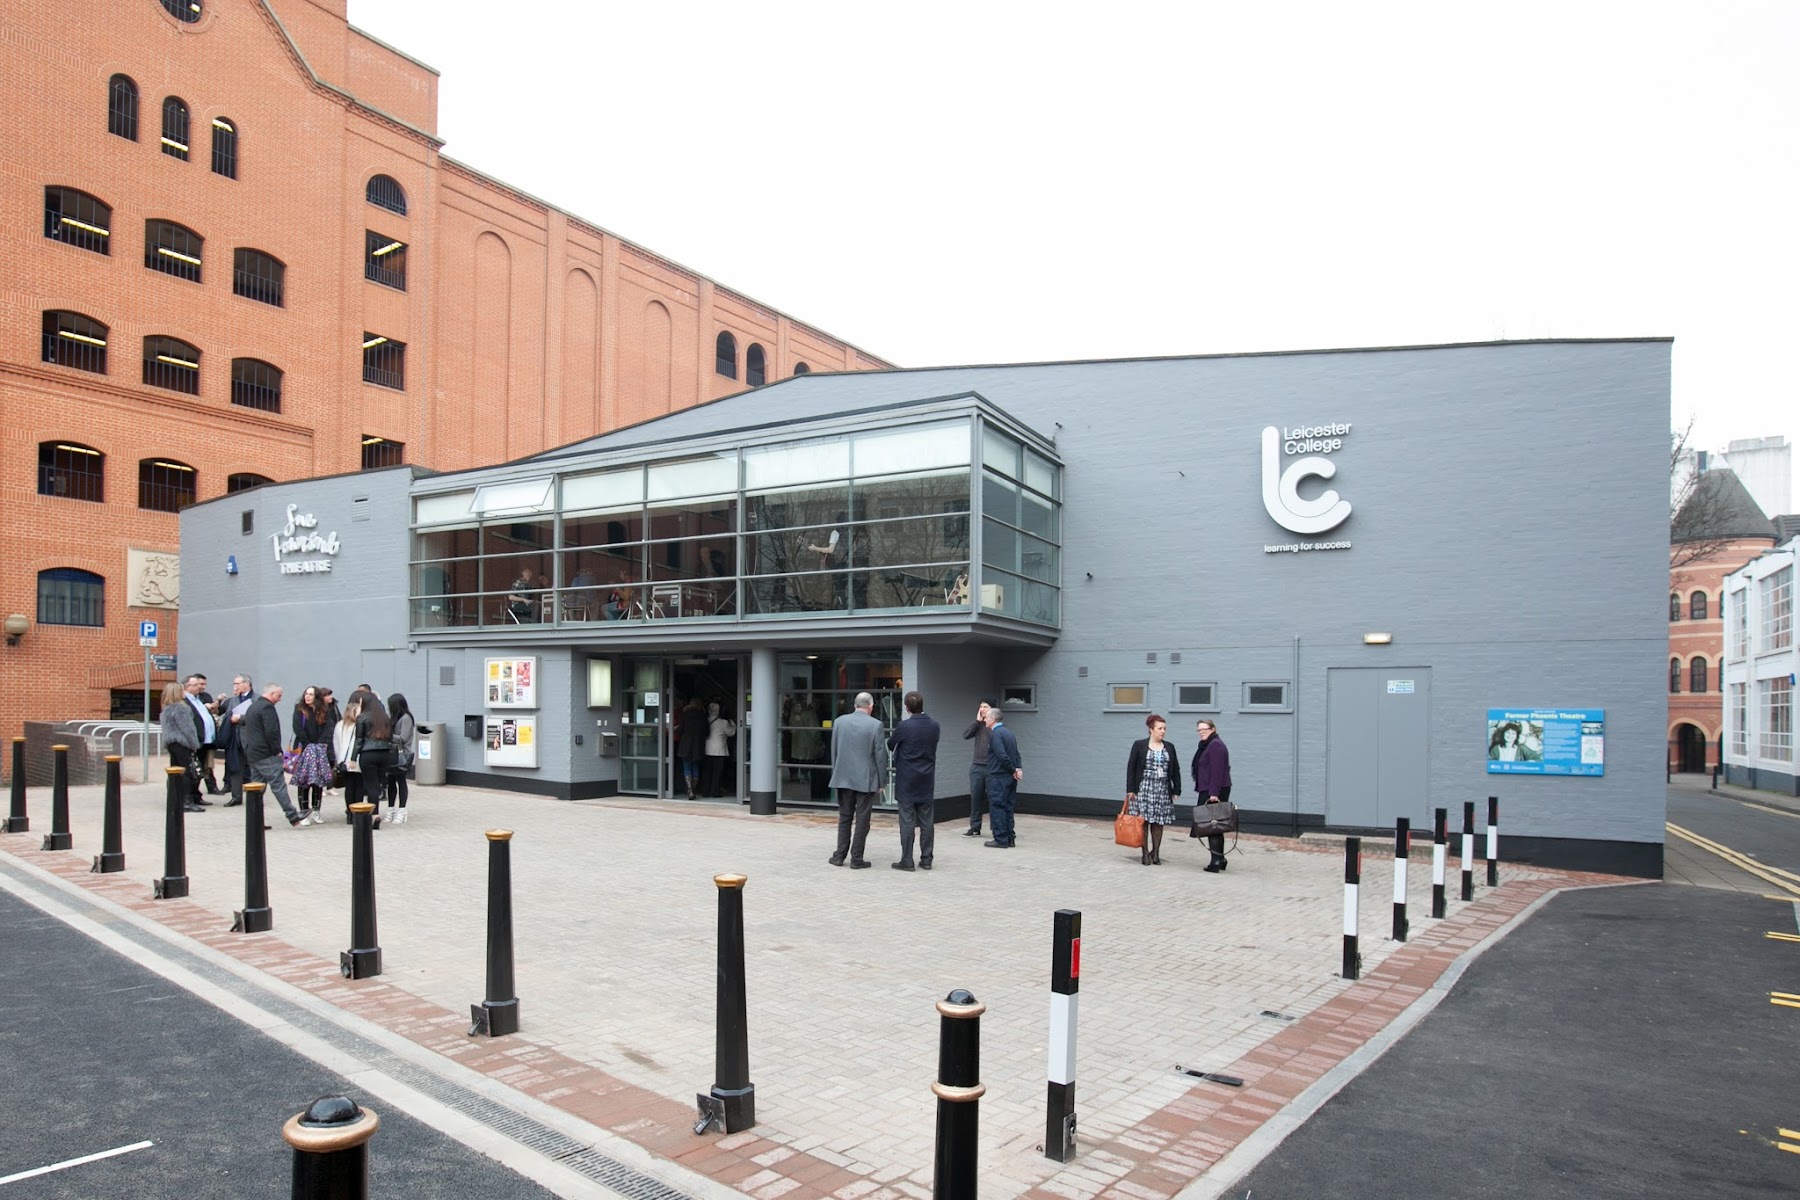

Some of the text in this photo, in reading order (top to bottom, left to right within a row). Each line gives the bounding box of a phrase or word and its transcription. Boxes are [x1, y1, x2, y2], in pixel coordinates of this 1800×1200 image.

[1284, 422, 1352, 441] Leicester
[1284, 439, 1342, 455] College
[283, 503, 317, 537] Sue
[1264, 540, 1352, 553] learning for success
[279, 559, 332, 574] THEATRE
[144, 623, 155, 637] P
